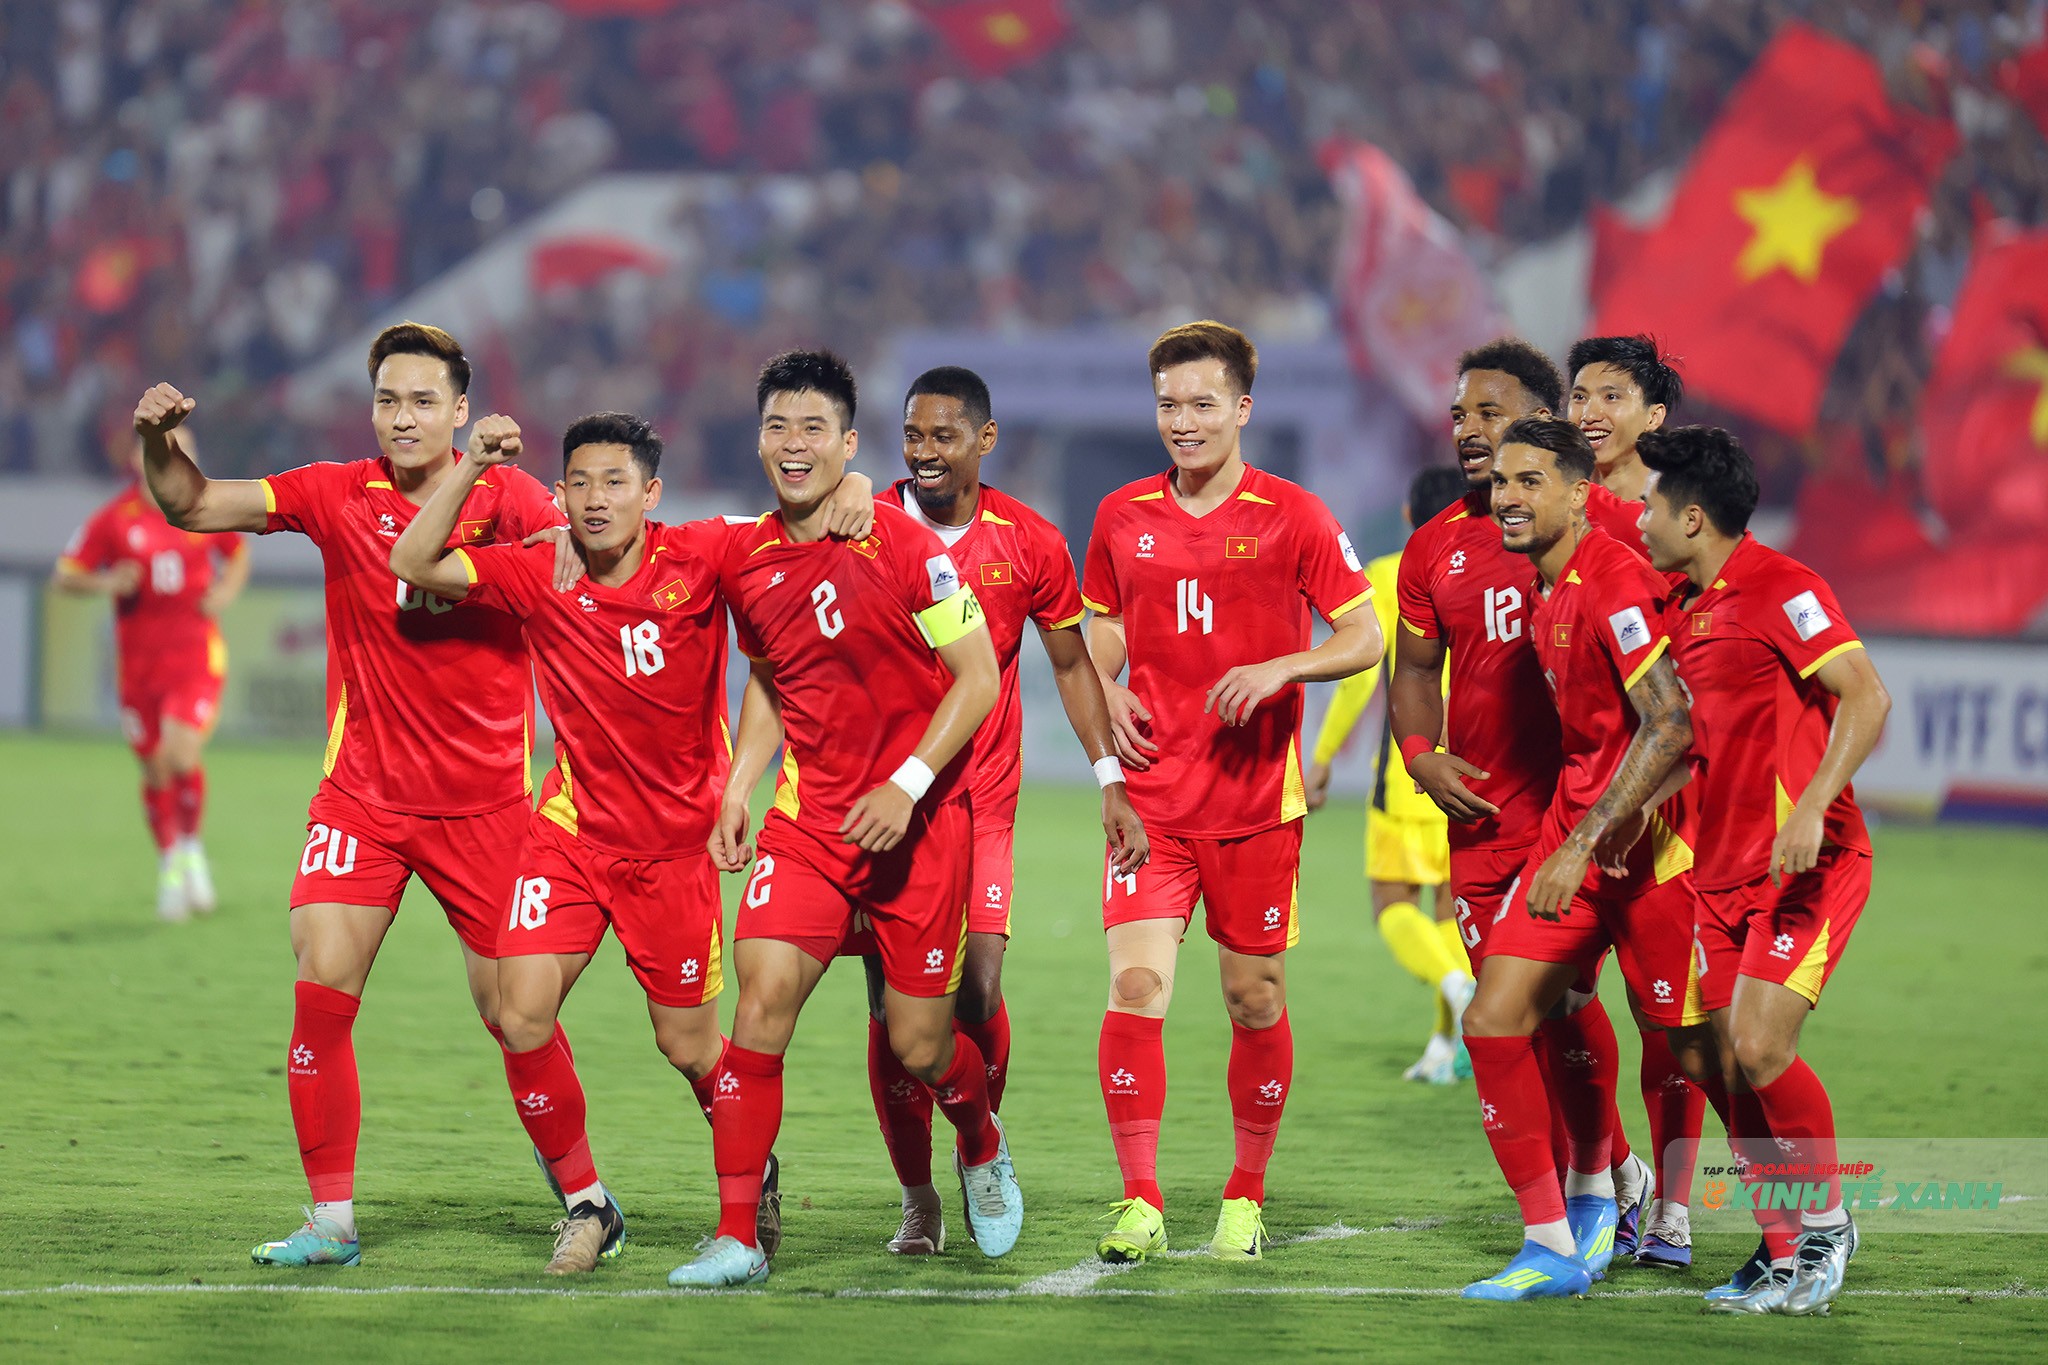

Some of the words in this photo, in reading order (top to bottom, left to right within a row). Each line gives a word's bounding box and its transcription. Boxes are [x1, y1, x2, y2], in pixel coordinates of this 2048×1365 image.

[810, 579, 845, 640] 2
[1177, 577, 1213, 635] 14
[1484, 586, 1521, 643] 12
[1621, 621, 1641, 639] AFC
[1797, 606, 1818, 625] AFC
[620, 619, 666, 678] 18
[1910, 680, 1996, 764] VFF
[300, 823, 358, 877] 20
[508, 875, 551, 931] 18
[746, 854, 775, 909] 2
